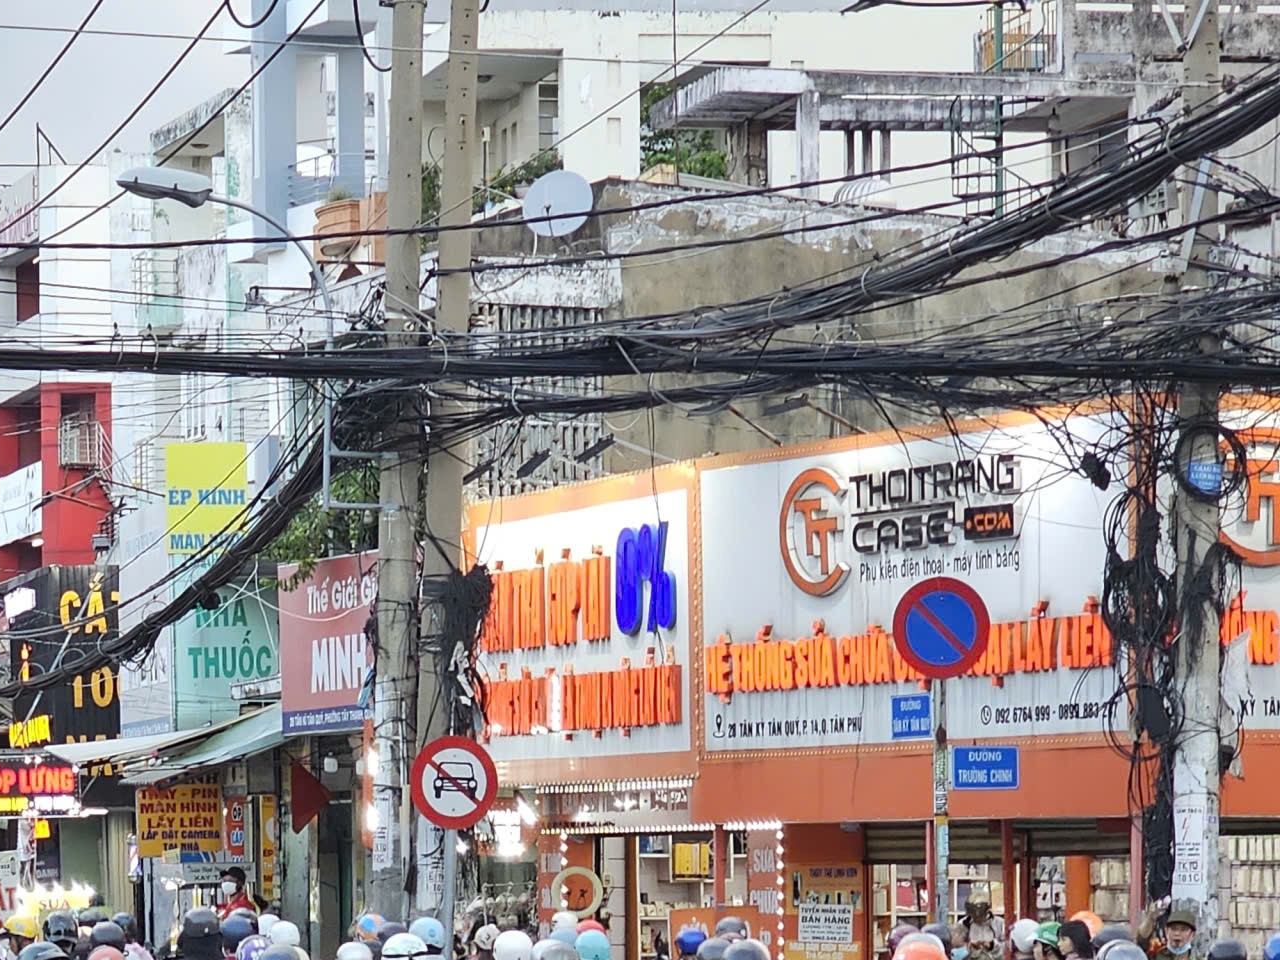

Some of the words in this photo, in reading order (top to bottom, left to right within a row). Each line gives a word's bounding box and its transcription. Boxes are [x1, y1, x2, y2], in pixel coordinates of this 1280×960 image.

[860, 563, 877, 587] Phụ
[880, 559, 898, 584] kiện
[900, 557, 920, 583] điện
[953, 553, 973, 577] máy
[975, 550, 993, 571] tính
[996, 546, 1020, 572] bảng
[307, 576, 329, 615] Thế
[332, 576, 357, 609] Giới
[187, 630, 272, 680] THUỐC
[705, 632, 732, 705] HỆ
[731, 624, 795, 693] THỐNG
[795, 619, 837, 688] SỬA
[837, 623, 893, 686] CHỮA
[1012, 600, 1056, 673] LẤY
[1060, 596, 1114, 669] LIỀN
[311, 632, 368, 694] MINH
[739, 719, 753, 738] TÂN
[768, 717, 782, 736] TÂN
[830, 714, 844, 733] TÂN
[847, 711, 863, 733] PHÚ
[995, 708, 1010, 724] 092
[1035, 704, 1051, 722] 999
[18, 764, 76, 794] LƯNG
[958, 766, 988, 783] TRƯỜNG
[990, 769, 1013, 783] CHINH
[191, 788, 219, 800] PIN
[180, 800, 218, 814] HÌNH
[147, 815, 176, 829] LẤY
[181, 829, 220, 840] CAMERA
[801, 915, 821, 924] BÁN
[824, 915, 851, 925] HÀNG
